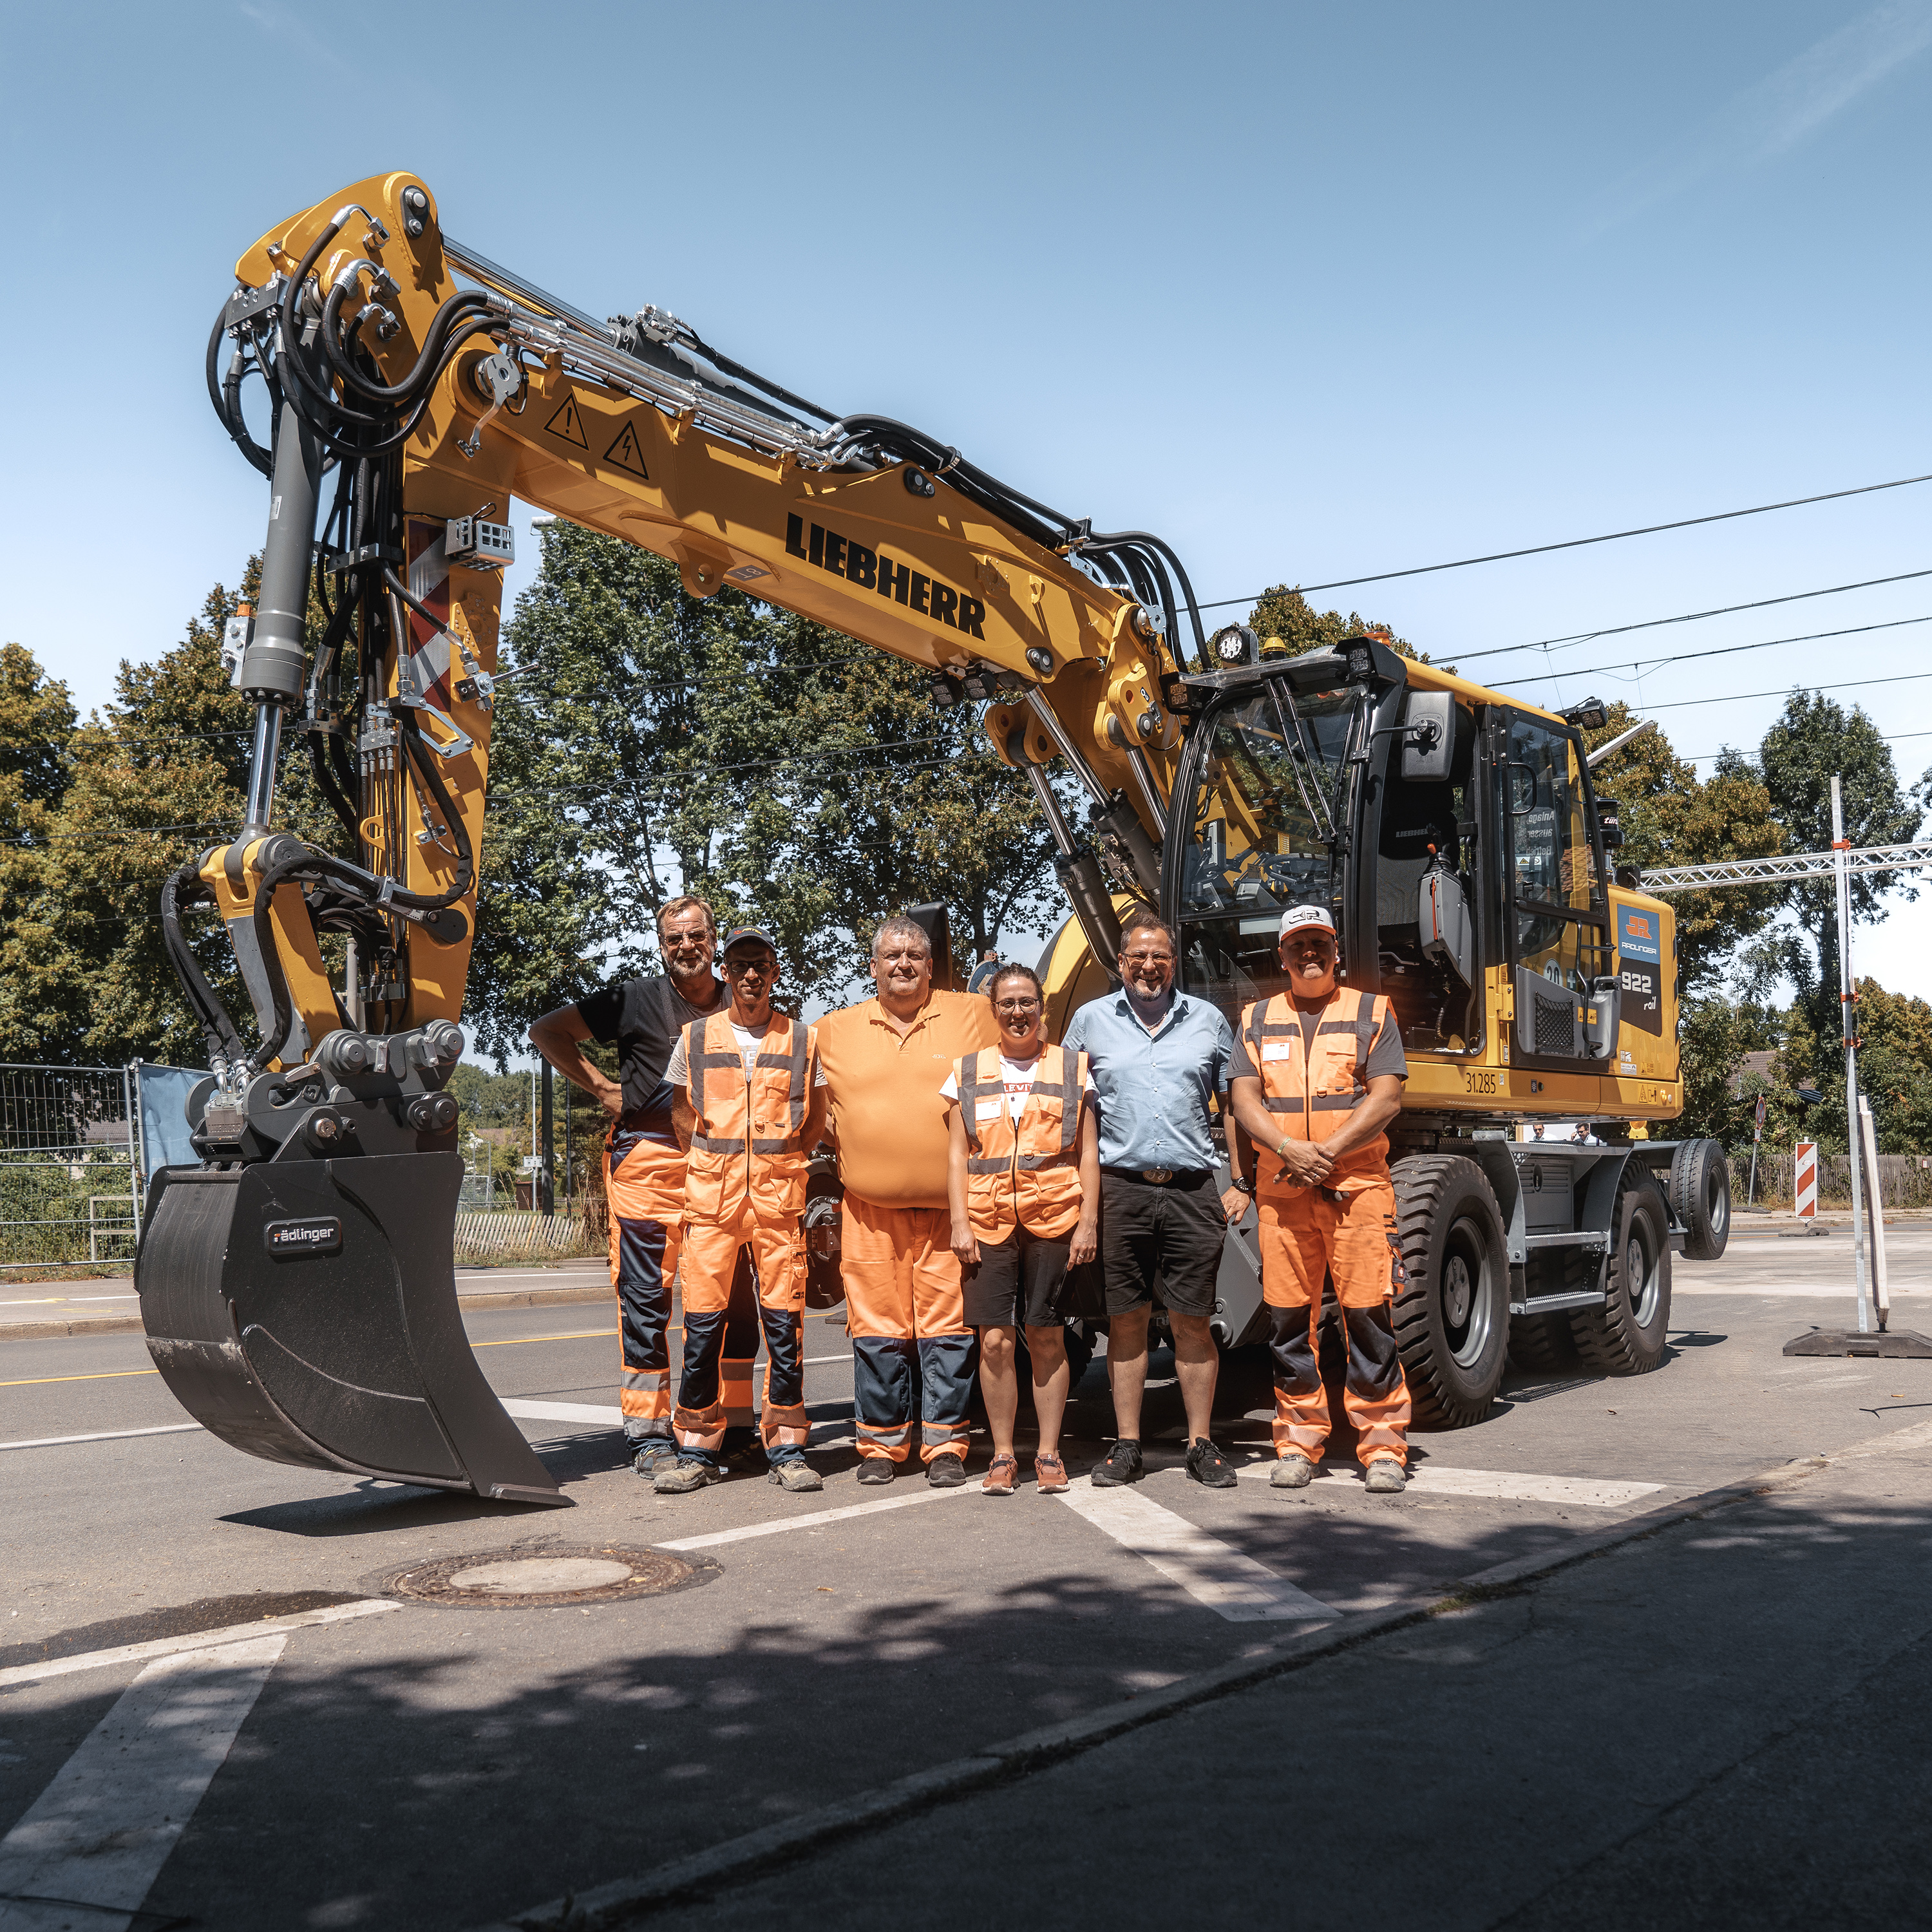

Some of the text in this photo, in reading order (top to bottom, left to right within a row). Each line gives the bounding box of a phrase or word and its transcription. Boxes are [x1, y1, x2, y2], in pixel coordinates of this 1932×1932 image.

[785, 511, 986, 642] LIEBHERR
[1622, 971, 1651, 994] 922
[1643, 996, 1656, 1010] rail
[1466, 1072, 1496, 1094] 31.285
[274, 1228, 334, 1242] rädlinger
